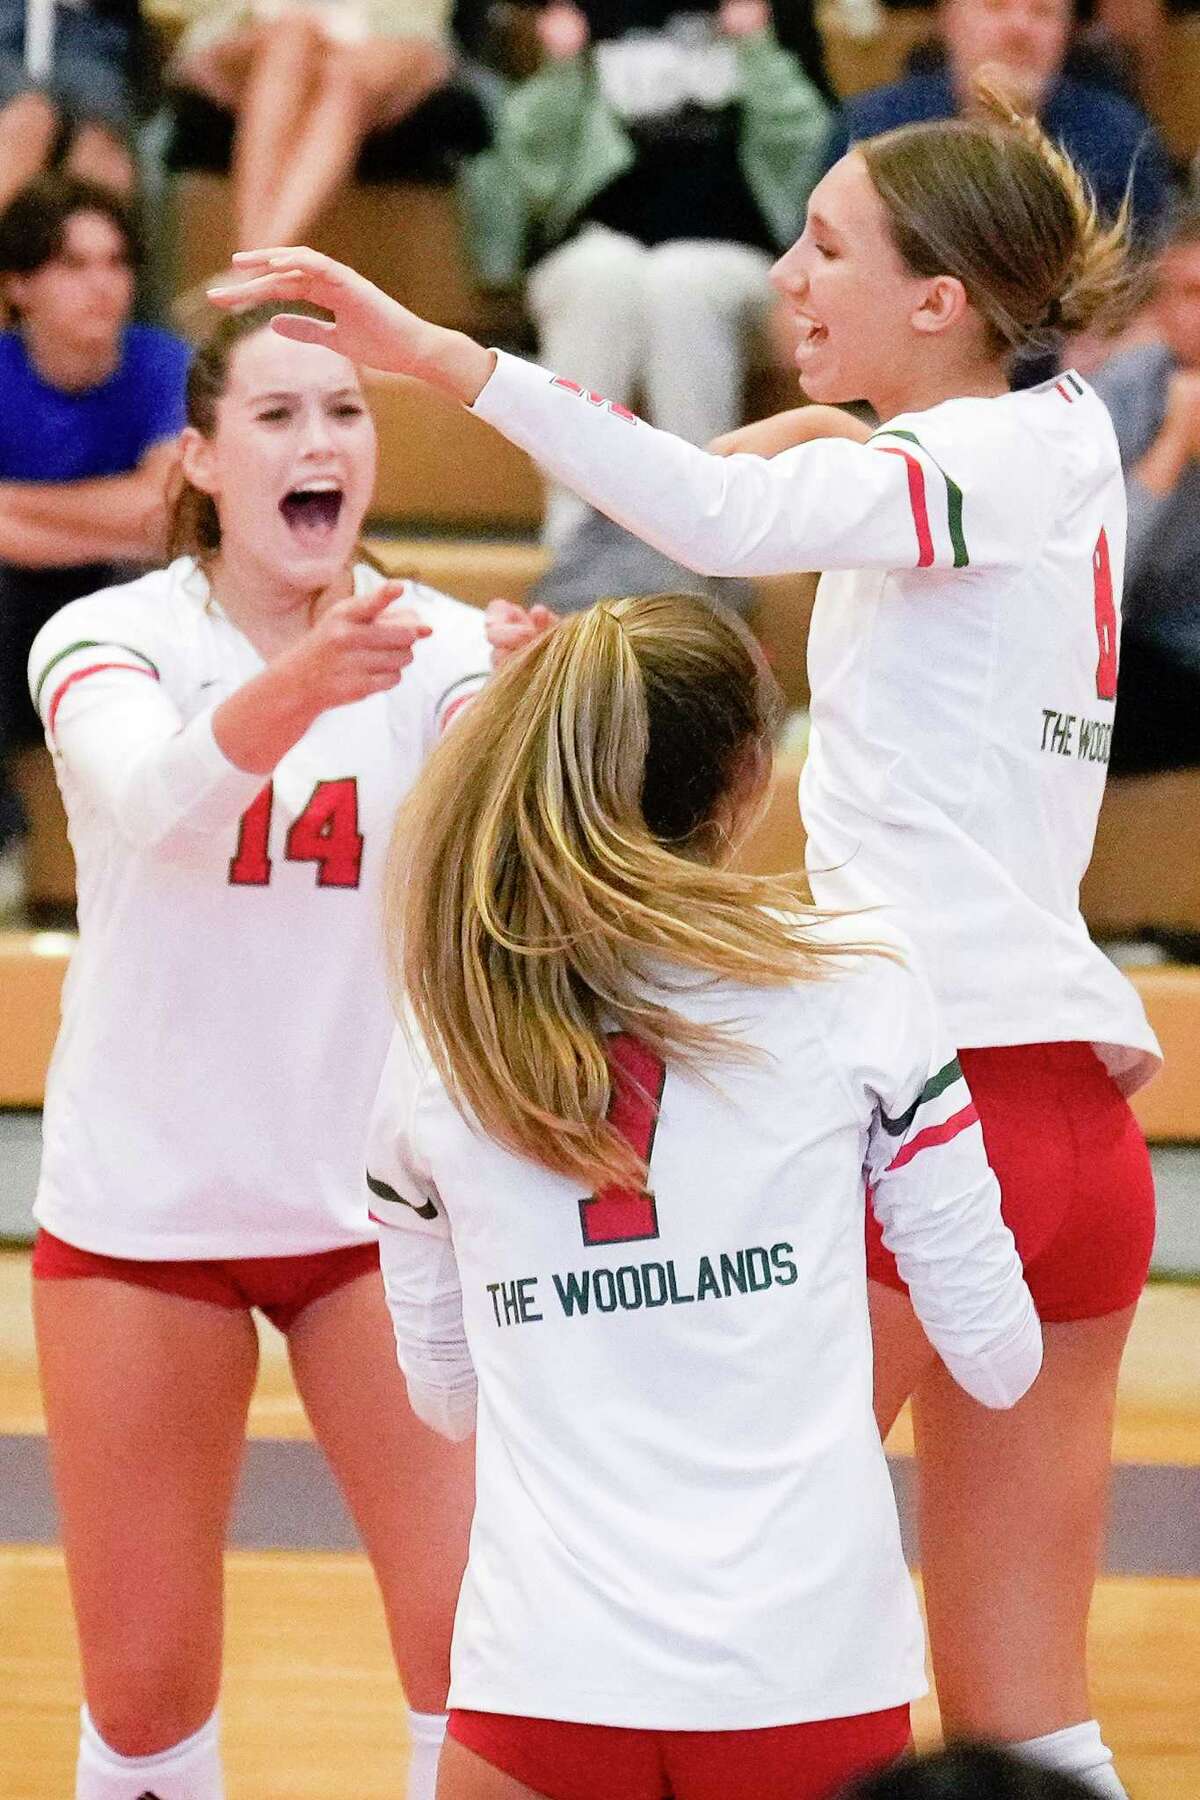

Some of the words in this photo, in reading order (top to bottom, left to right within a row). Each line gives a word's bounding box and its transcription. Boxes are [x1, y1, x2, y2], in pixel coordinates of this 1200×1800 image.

[1041, 709, 1076, 757] THE
[227, 776, 364, 889] 14
[486, 1276, 544, 1328] THE
[552, 1242, 799, 1318] WOODLANDS
